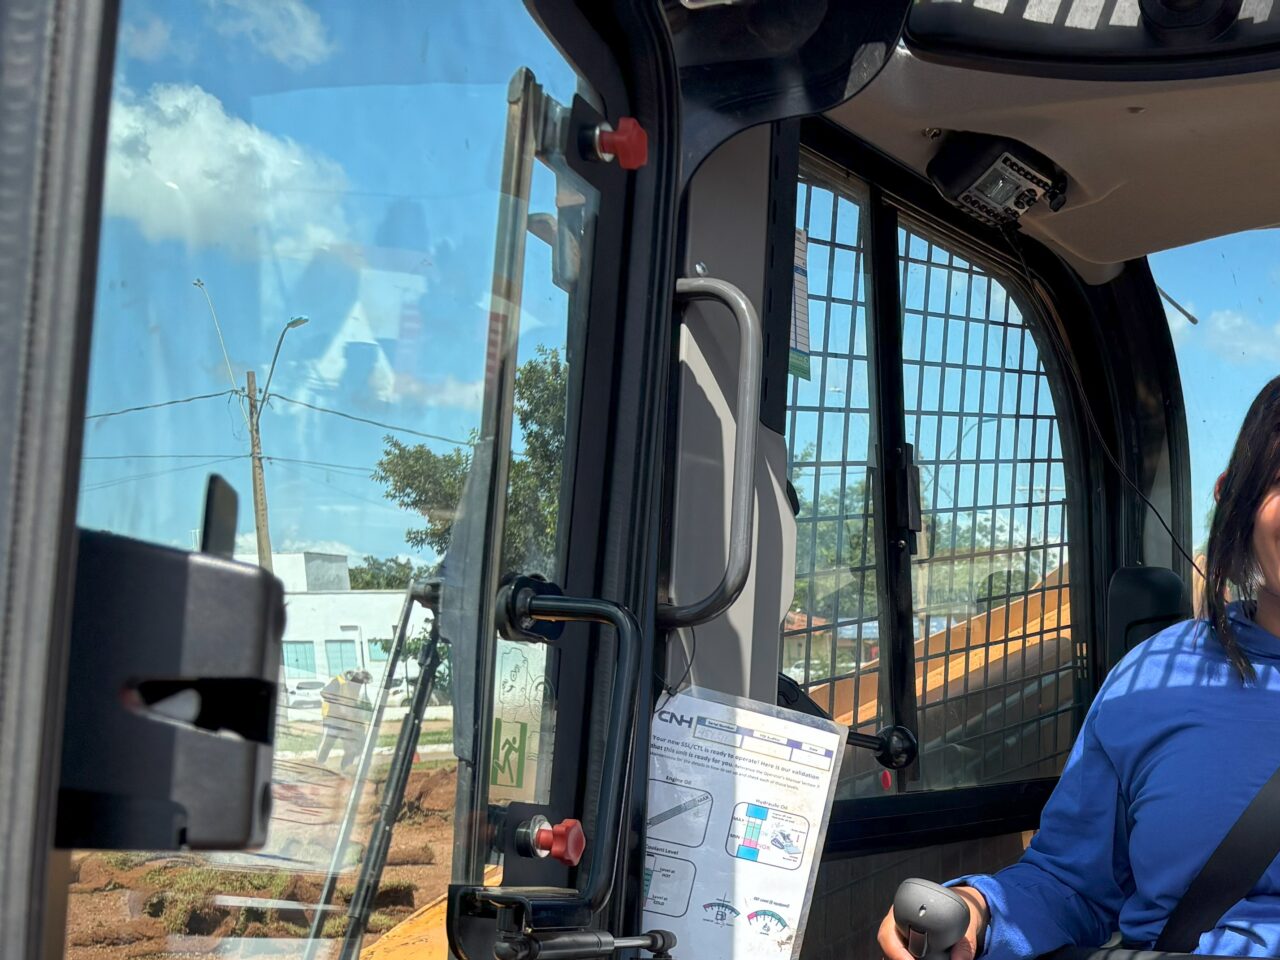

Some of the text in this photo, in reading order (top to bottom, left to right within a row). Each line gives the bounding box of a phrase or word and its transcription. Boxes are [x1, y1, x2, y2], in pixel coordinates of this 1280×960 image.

[658, 710, 694, 728] CNH
[663, 745, 675, 753] this
[694, 753, 711, 763] ready
[667, 738, 680, 746] new
[710, 748, 727, 759] ready
[666, 775, 683, 783] Engine
